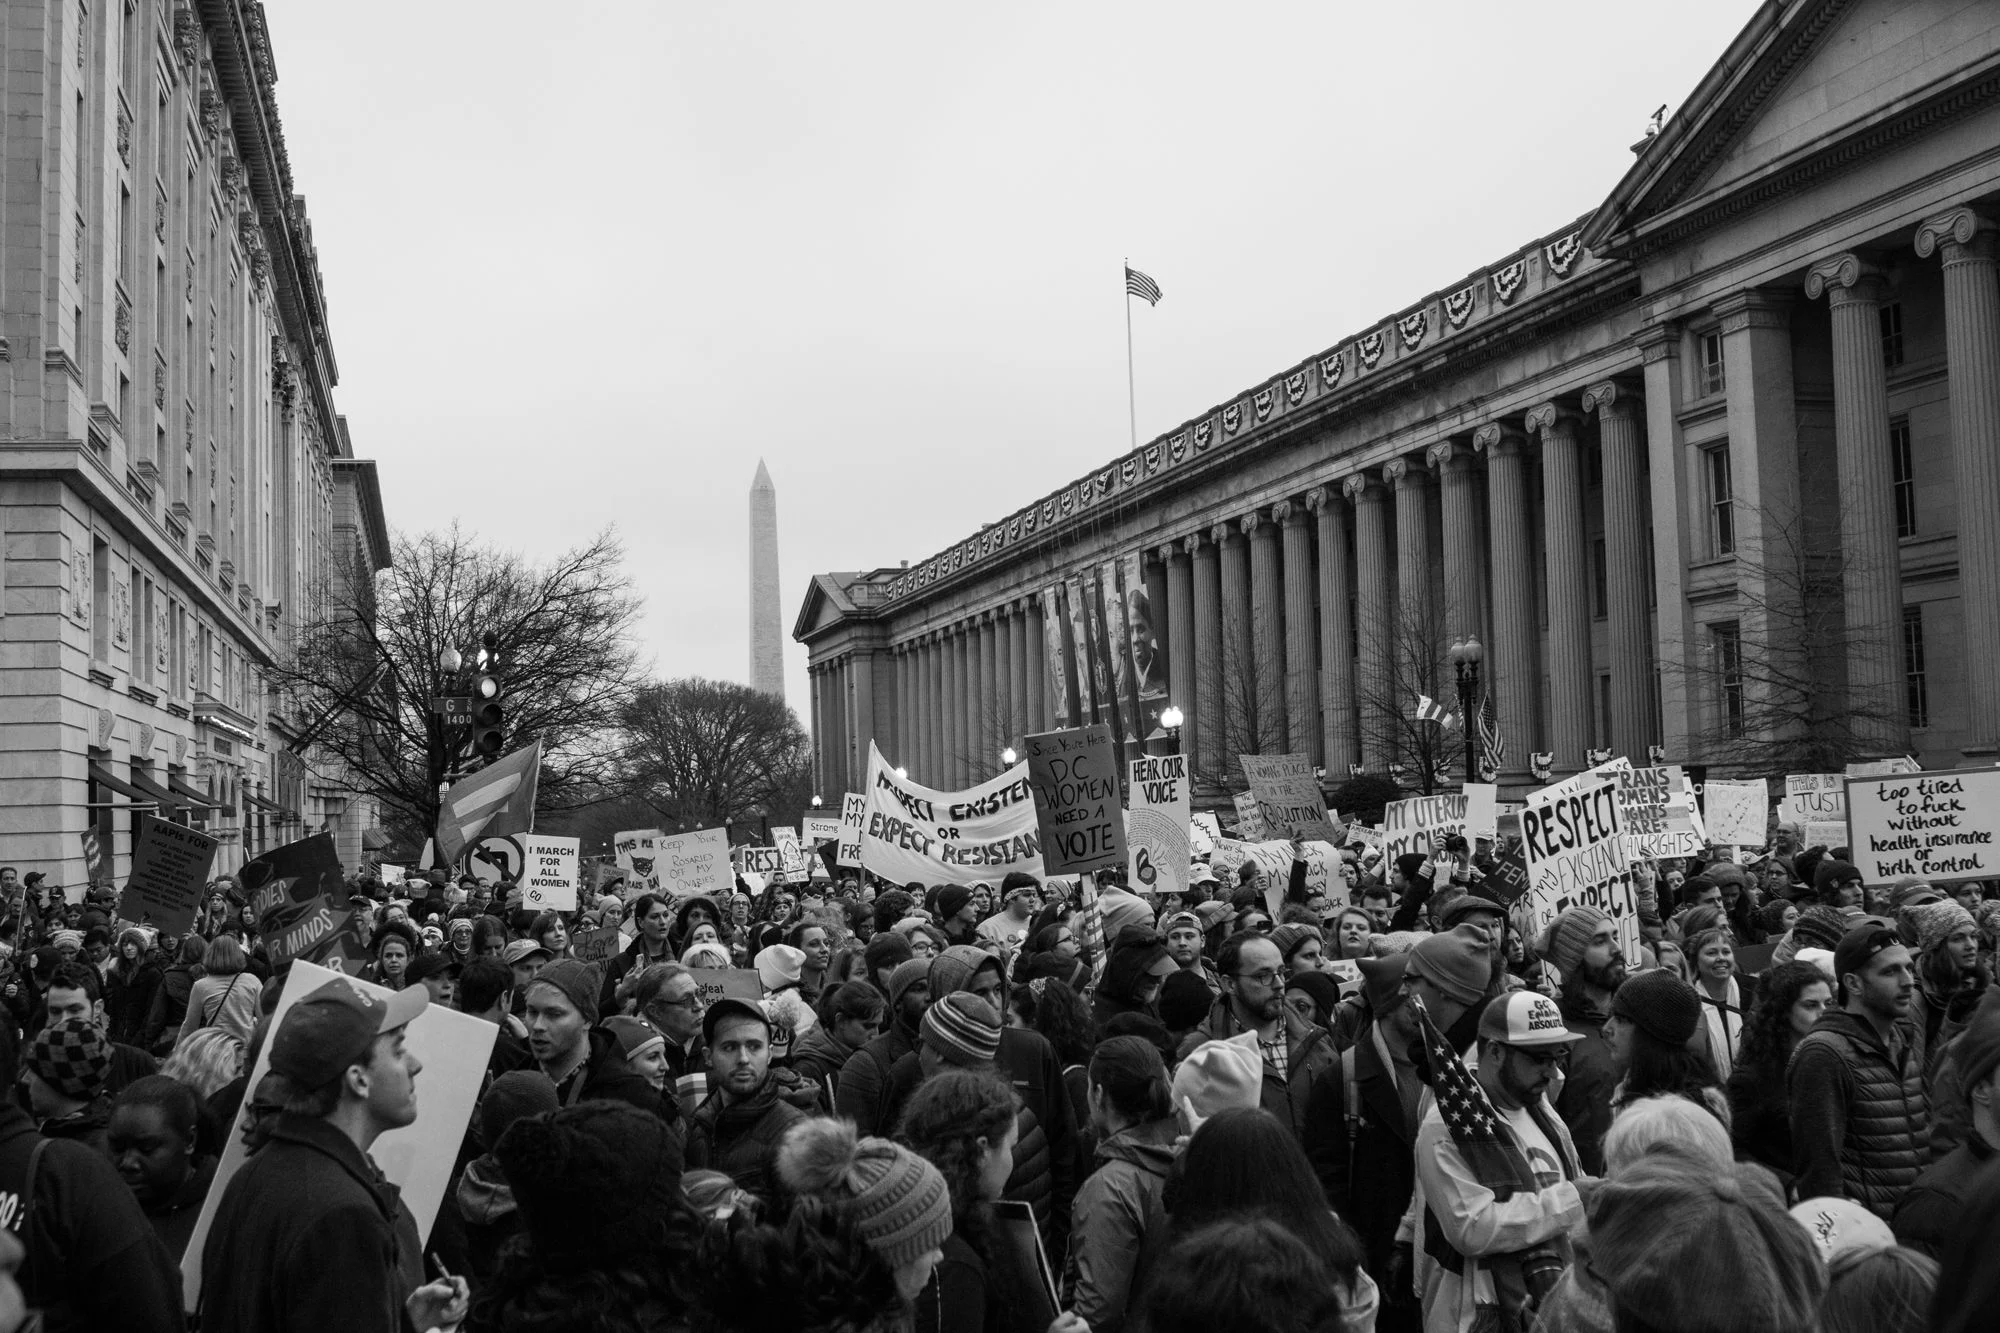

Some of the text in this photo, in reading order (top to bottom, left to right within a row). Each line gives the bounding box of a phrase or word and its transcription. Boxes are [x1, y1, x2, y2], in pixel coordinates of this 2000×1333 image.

[446, 700, 455, 712] G
[447, 714, 472, 724] 1400
[1049, 755, 1089, 784] DC
[1133, 757, 1185, 782] HEAR OUR
[1041, 776, 1114, 810] WOMEN
[1142, 779, 1178, 804] VOICE
[1788, 775, 1836, 791] THIS IS
[1876, 778, 1964, 801] too tired
[1793, 791, 1845, 814] JUST
[1896, 795, 1966, 815] to fuck
[1055, 804, 1105, 826] NEED A
[1386, 794, 1469, 832] MY UTERUS
[1621, 804, 1667, 822] IGHTS
[1888, 814, 1961, 831] without
[810, 822, 839, 834] Strong
[937, 827, 960, 840] OR
[1523, 783, 1618, 864] RESPECT
[153, 824, 209, 850] AAPIs FOR
[868, 812, 935, 856] EXPECT
[1055, 823, 1115, 861] VOTE
[1648, 832, 1693, 856] RIGHTS
[1870, 831, 1992, 852] health insurance
[529, 846, 574, 856] I MARCH
[616, 839, 638, 854] THIS
[1914, 849, 1934, 861] or
[540, 858, 560, 866] FOR
[540, 868, 560, 876] ALL
[696, 864, 712, 874] MY
[1558, 832, 1629, 894] EXISTENCE
[1877, 853, 1984, 878] birth control
[531, 878, 570, 888] WOMEN
[530, 890, 542, 902] CO
[286, 908, 334, 956] MINDS
[698, 982, 724, 994] efeat
